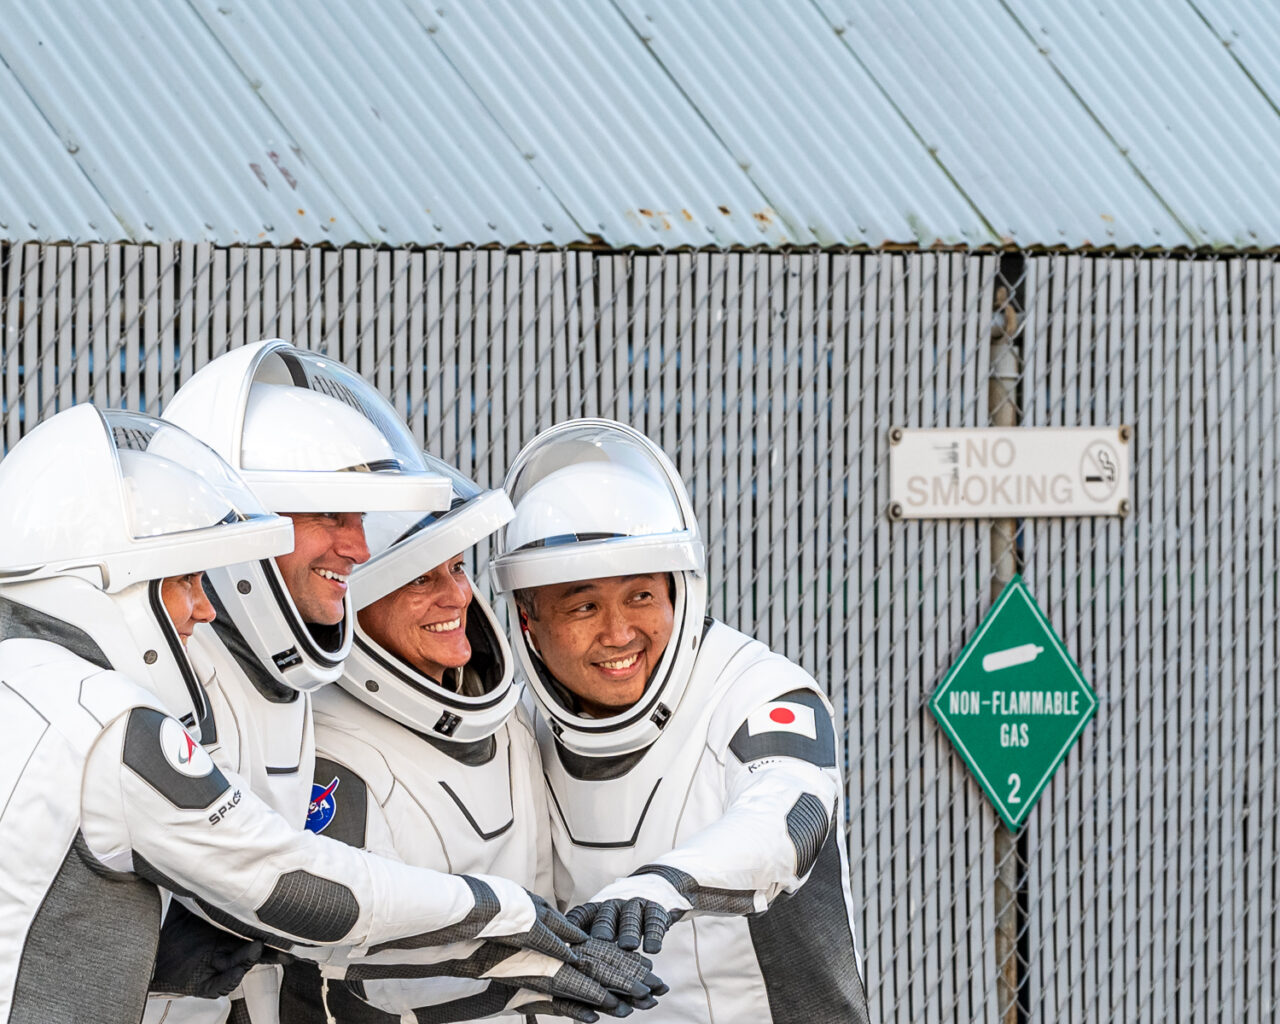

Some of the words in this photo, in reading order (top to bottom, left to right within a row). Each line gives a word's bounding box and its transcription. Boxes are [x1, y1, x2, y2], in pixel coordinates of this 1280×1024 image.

[966, 437, 1017, 469] NO
[906, 474, 1074, 507] SMOKING
[949, 690, 1080, 716] NON-FLAMMABLE
[1000, 723, 1030, 748] GAS
[1007, 773, 1021, 804] 2
